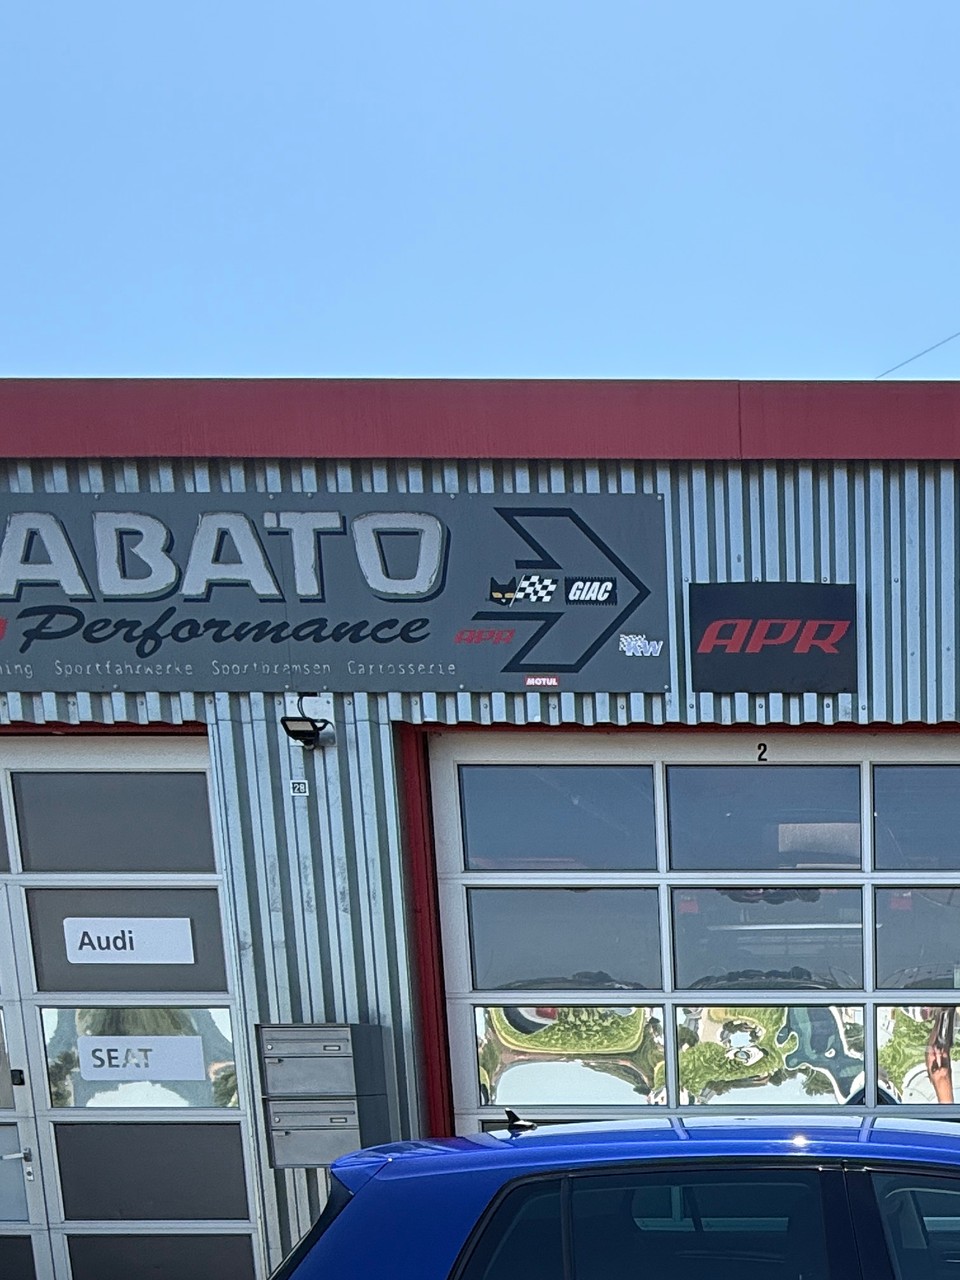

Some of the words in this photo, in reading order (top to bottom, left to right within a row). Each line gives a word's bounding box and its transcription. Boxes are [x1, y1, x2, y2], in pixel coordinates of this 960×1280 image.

[568, 581, 613, 602] GIAC
[16, 605, 430, 658] Performance
[697, 618, 851, 654] APR
[347, 660, 456, 675] Carrosserie
[525, 677, 558, 686] MOTUL
[757, 743, 768, 762] 2
[293, 783, 305, 793] 28
[78, 929, 135, 951] Audi
[91, 1048, 153, 1069] SEAT
